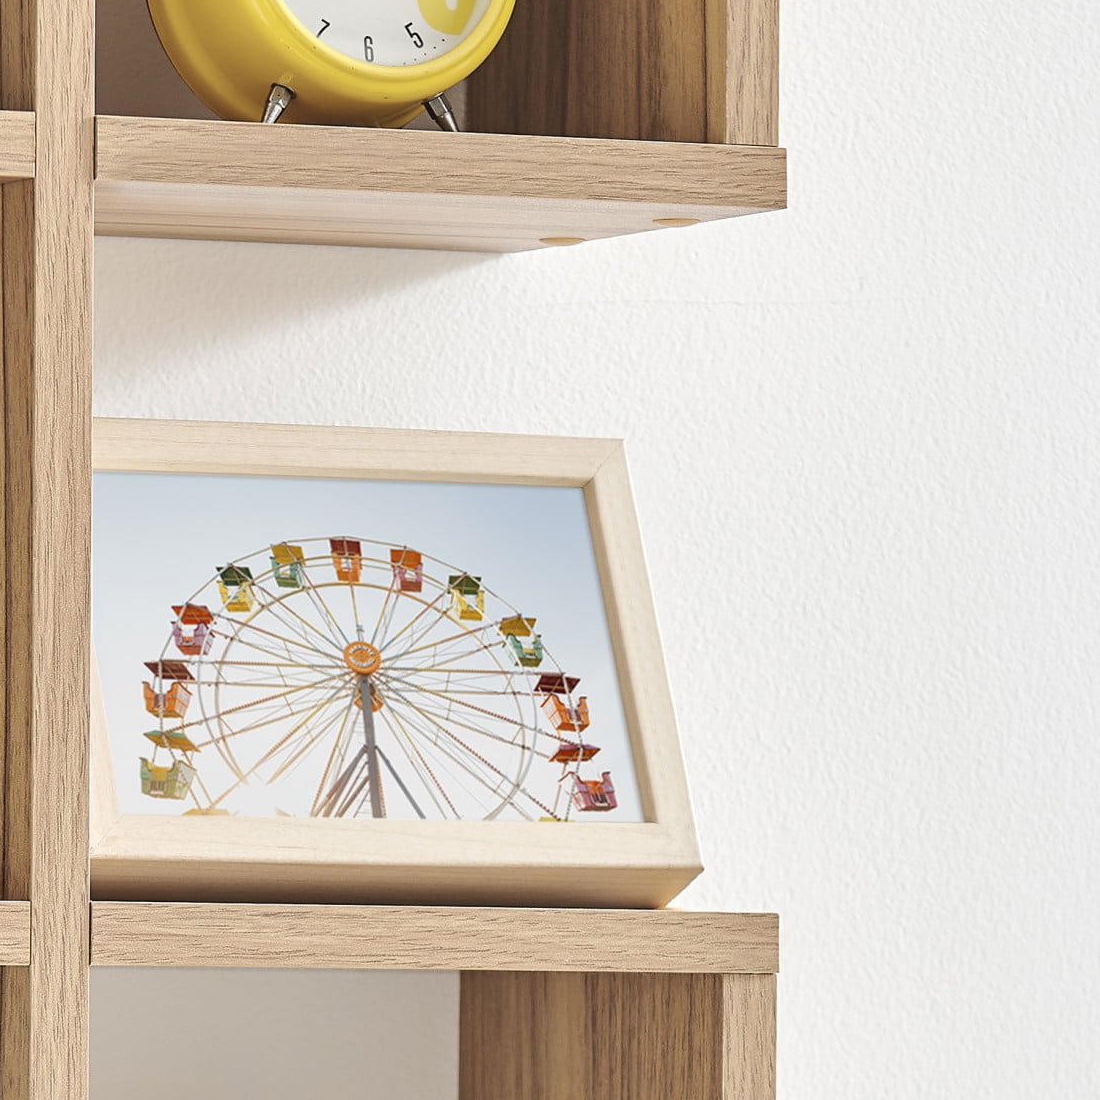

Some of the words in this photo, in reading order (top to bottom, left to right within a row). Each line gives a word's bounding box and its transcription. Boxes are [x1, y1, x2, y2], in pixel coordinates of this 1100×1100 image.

[316, 18, 331, 38] 7
[404, 22, 424, 49] 5
[363, 35, 374, 62] 6
